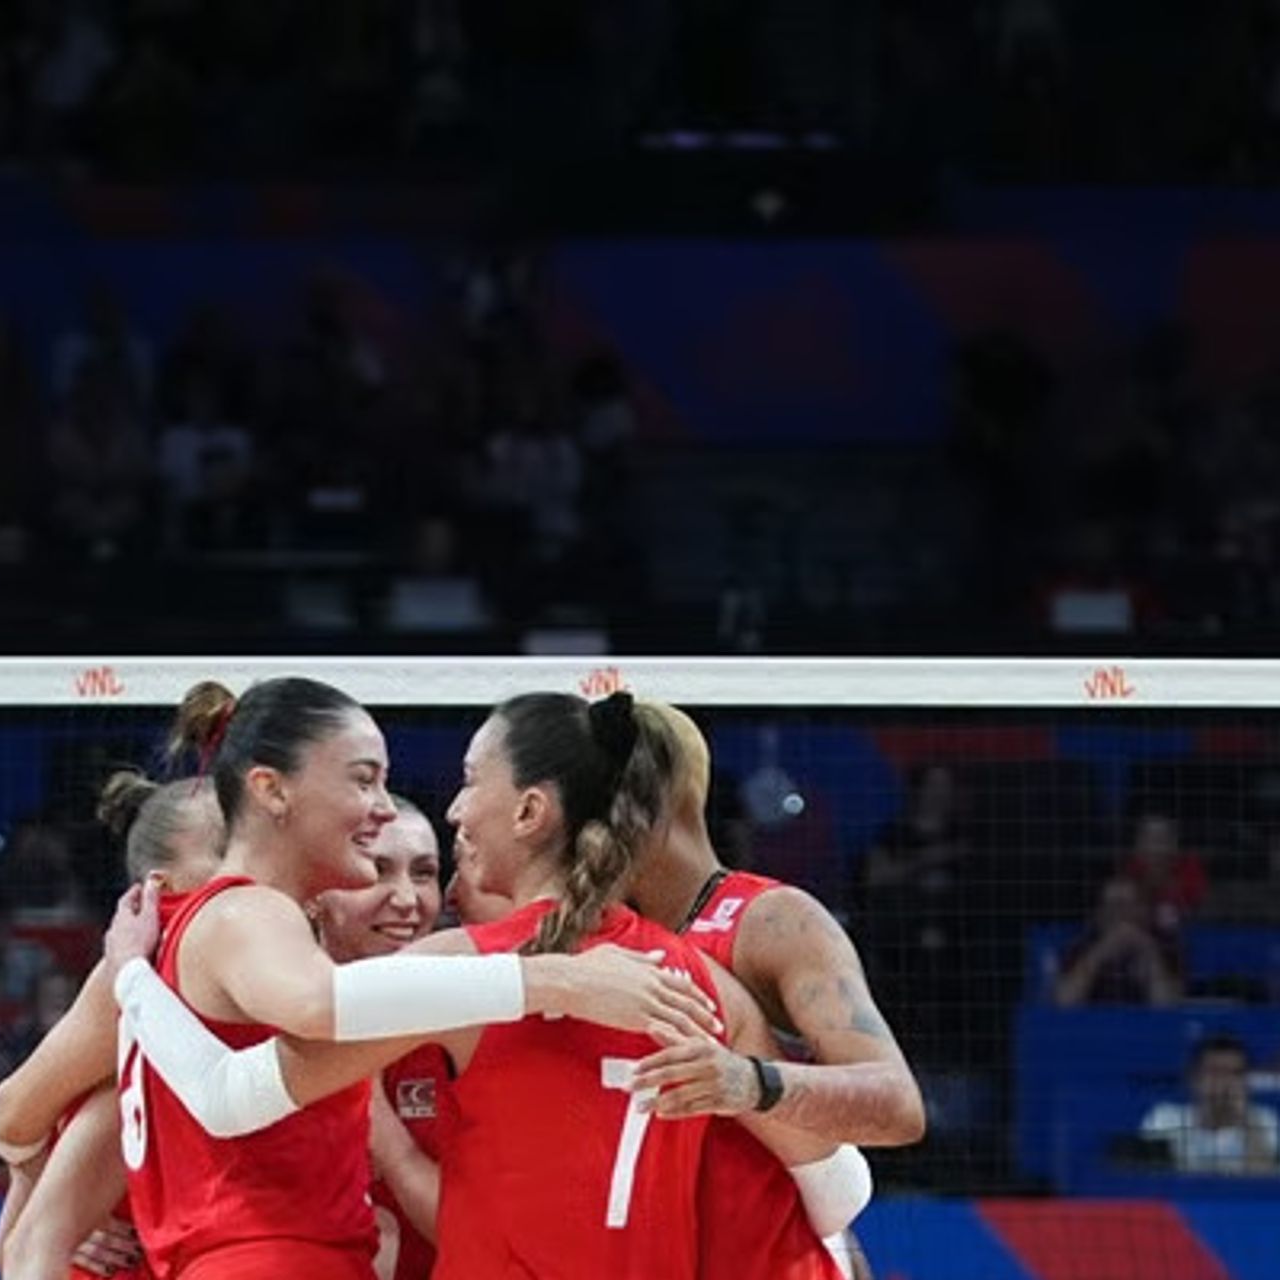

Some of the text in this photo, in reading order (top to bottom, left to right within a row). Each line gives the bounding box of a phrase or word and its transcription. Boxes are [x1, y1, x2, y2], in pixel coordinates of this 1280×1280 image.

[73, 667, 124, 698] VNL
[1085, 668, 1135, 701] VNL
[601, 1057, 661, 1229] 7
